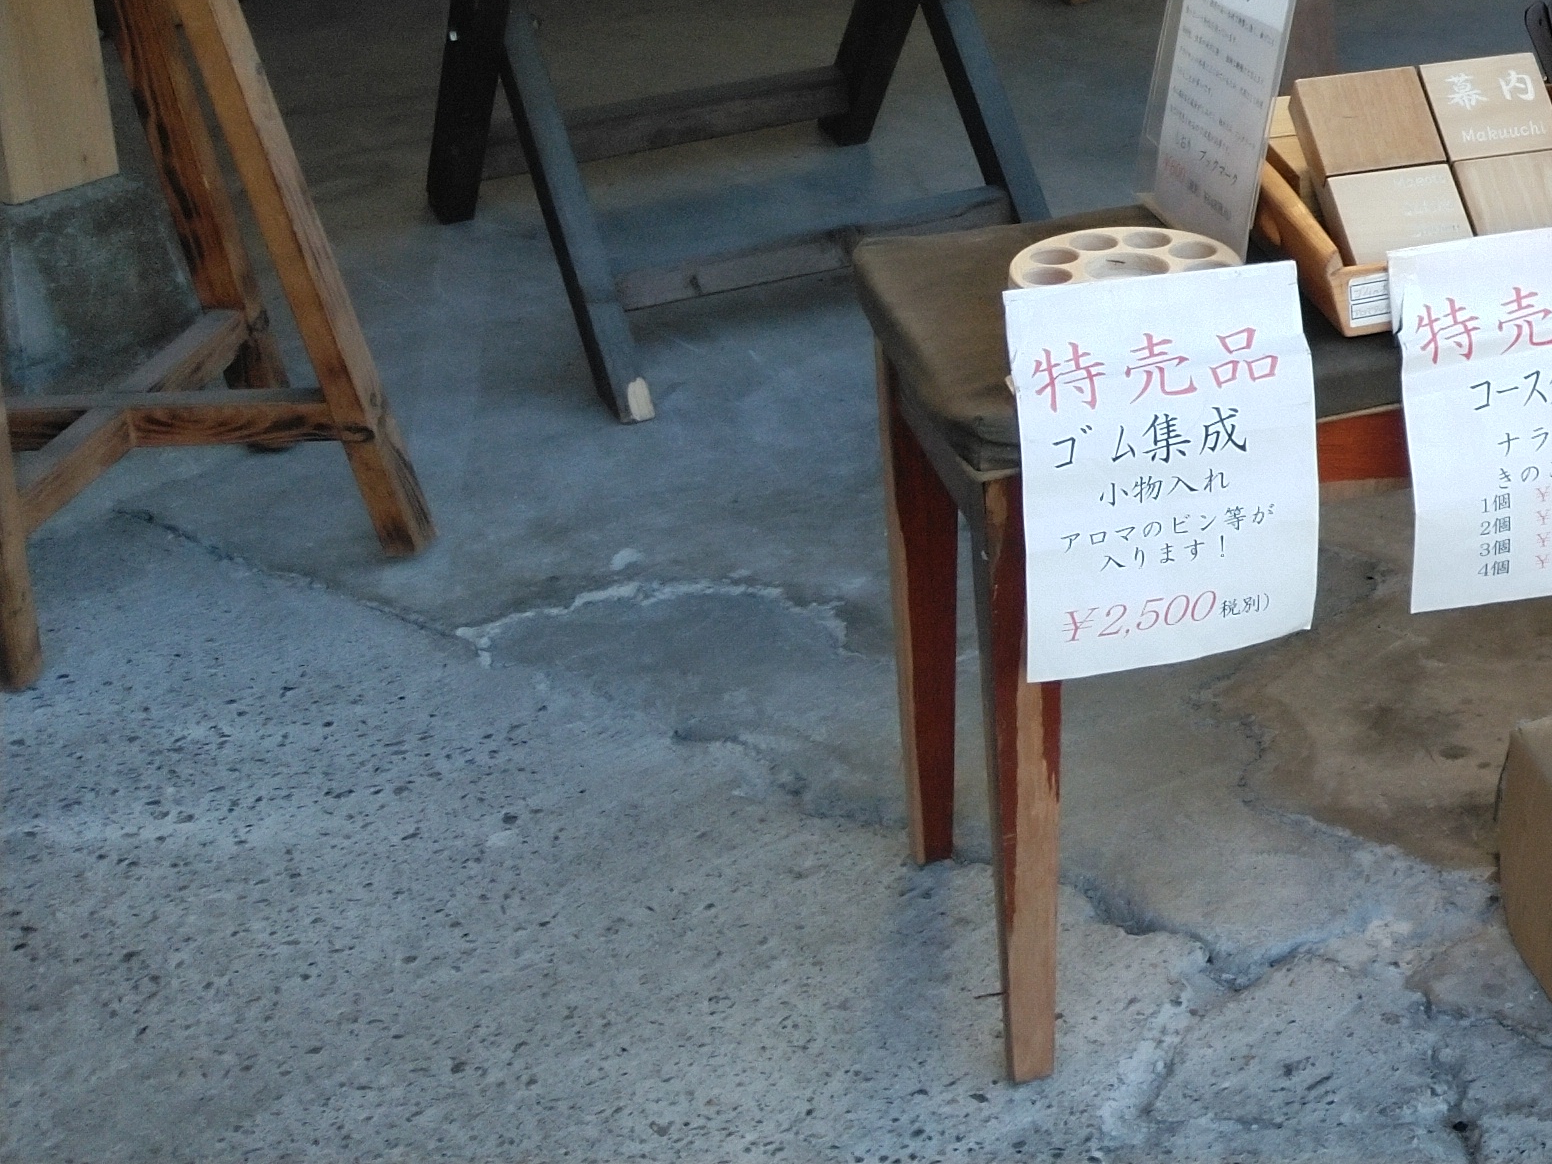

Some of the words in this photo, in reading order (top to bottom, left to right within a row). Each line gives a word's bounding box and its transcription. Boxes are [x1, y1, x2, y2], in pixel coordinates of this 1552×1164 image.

[1445, 69, 1536, 111] 幕内
[1462, 121, 1548, 144] Makuuchi
[1031, 327, 1279, 413] 特売品
[1052, 406, 1249, 469] ゴム集成
[1099, 468, 1230, 507] 小物入れ
[1481, 493, 1512, 514] 1個
[1060, 502, 1277, 554] アロマのビン等が
[1480, 516, 1512, 536] 2個
[1099, 535, 1228, 572] 入ります！
[1479, 538, 1512, 558] 3個
[1477, 559, 1511, 578] 4個
